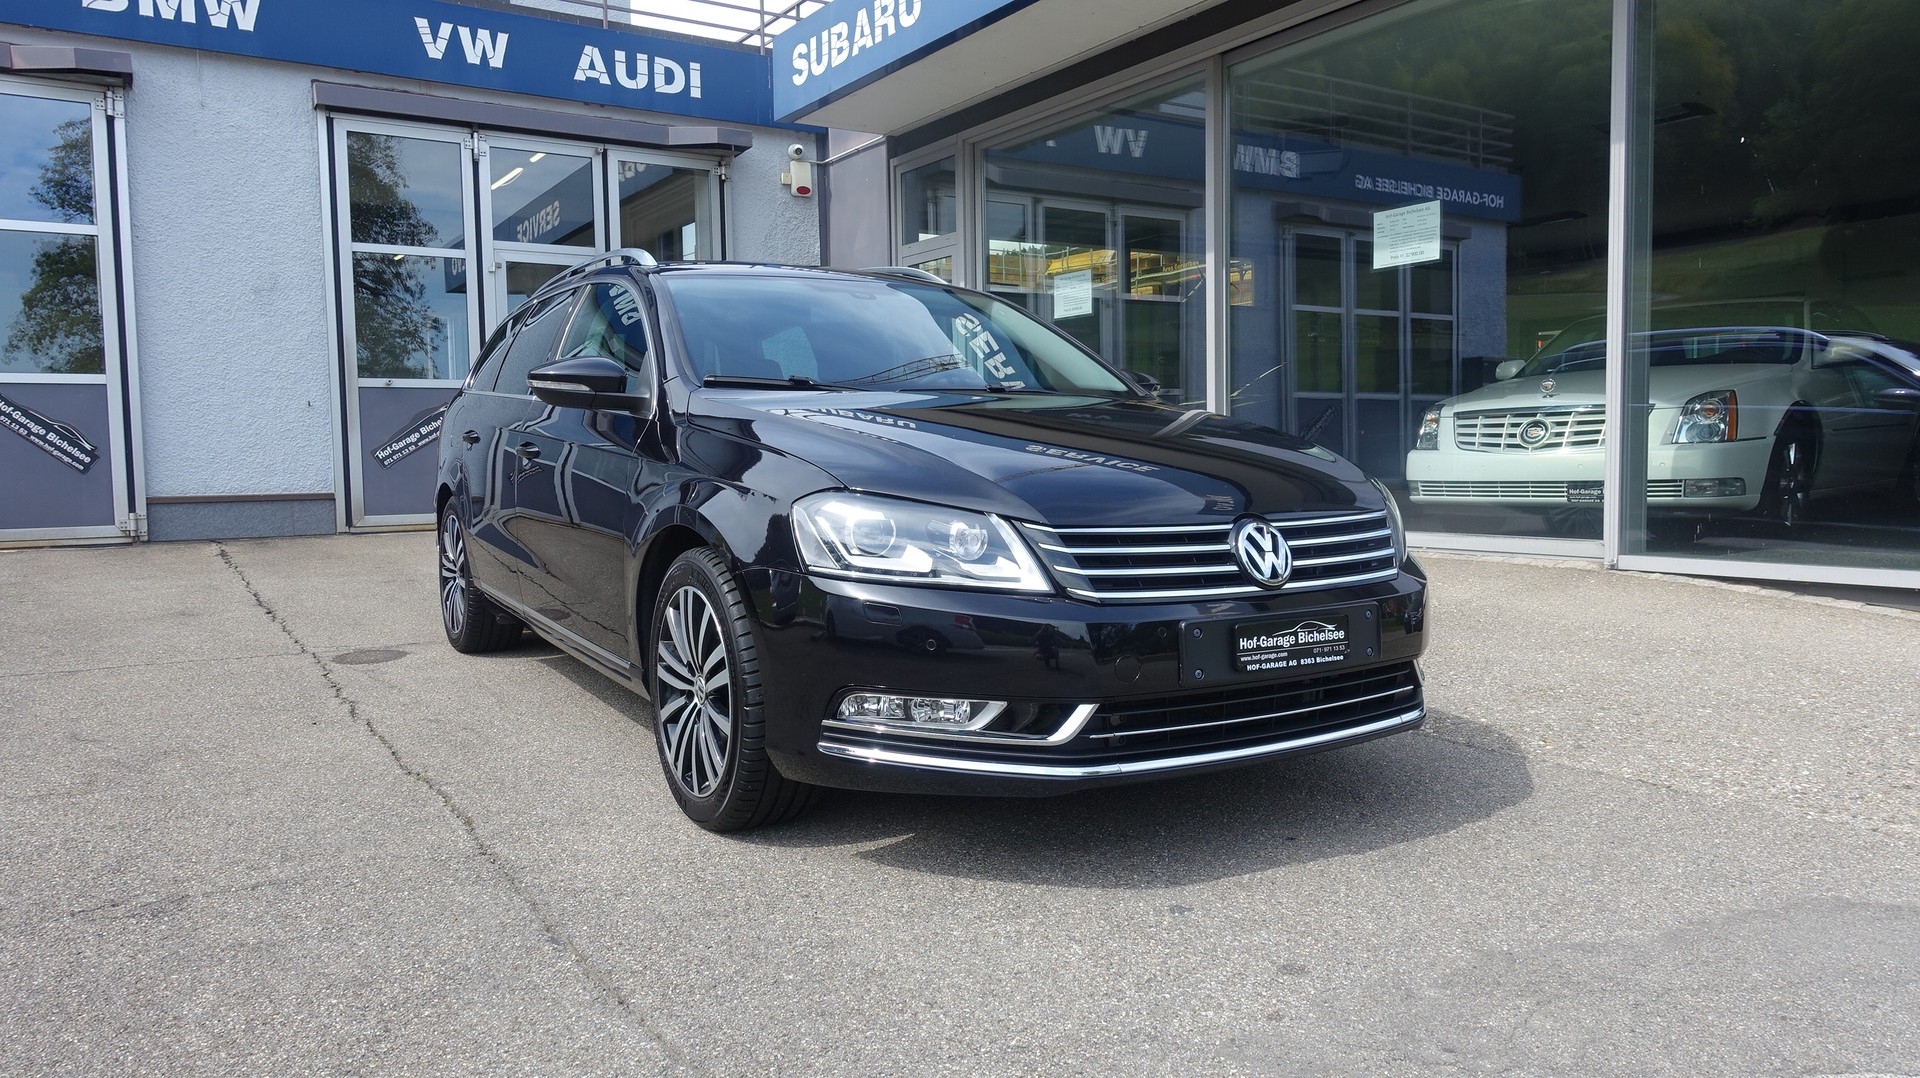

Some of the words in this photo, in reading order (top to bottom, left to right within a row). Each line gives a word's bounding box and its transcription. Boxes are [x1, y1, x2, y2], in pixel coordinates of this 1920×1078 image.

[413, 16, 509, 69] VW
[792, 0, 922, 86] SUBARU
[573, 44, 702, 99] AUDI
[46, 431, 92, 464] Bichelsee
[377, 432, 421, 460] Hof-Garage
[1240, 634, 1296, 650] Hof-Garage
[1298, 629, 1345, 644] Bichelsee
[1240, 651, 1288, 662] www.hof-garage.com
[1246, 660, 1287, 671] HOF-GARAGE
[1288, 659, 1298, 667] AG
[1300, 657, 1315, 665] 8363
[1316, 654, 1344, 663] Bichelsee
